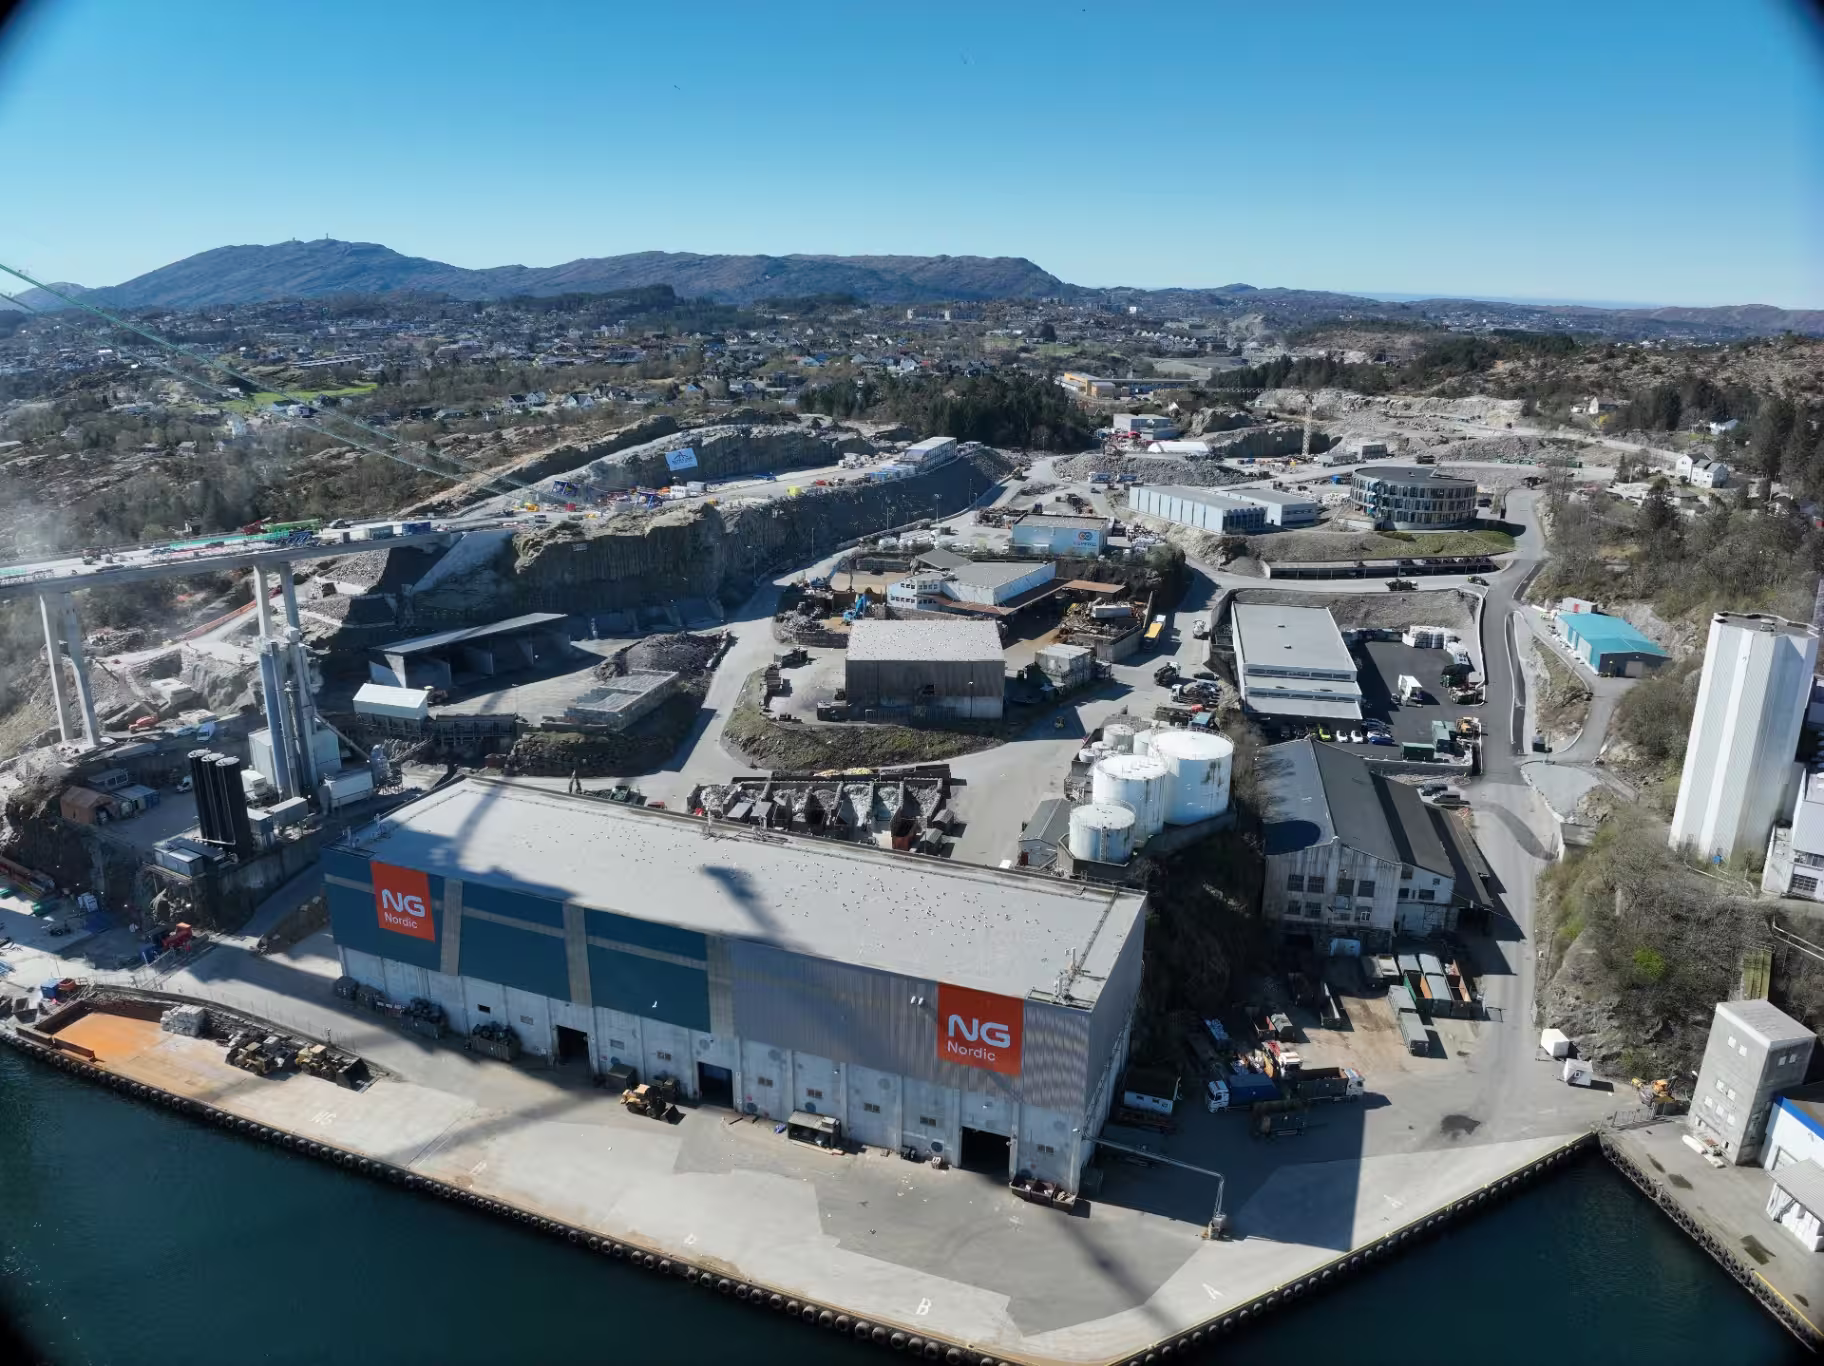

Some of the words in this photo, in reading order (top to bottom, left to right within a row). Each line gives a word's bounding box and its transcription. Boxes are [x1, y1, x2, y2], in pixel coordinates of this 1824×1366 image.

[382, 889, 426, 917] NG
[384, 911, 418, 929] Nordic
[948, 1014, 1011, 1048] NG
[947, 1040, 996, 1062] Nordic
[916, 1297, 932, 1316] B
